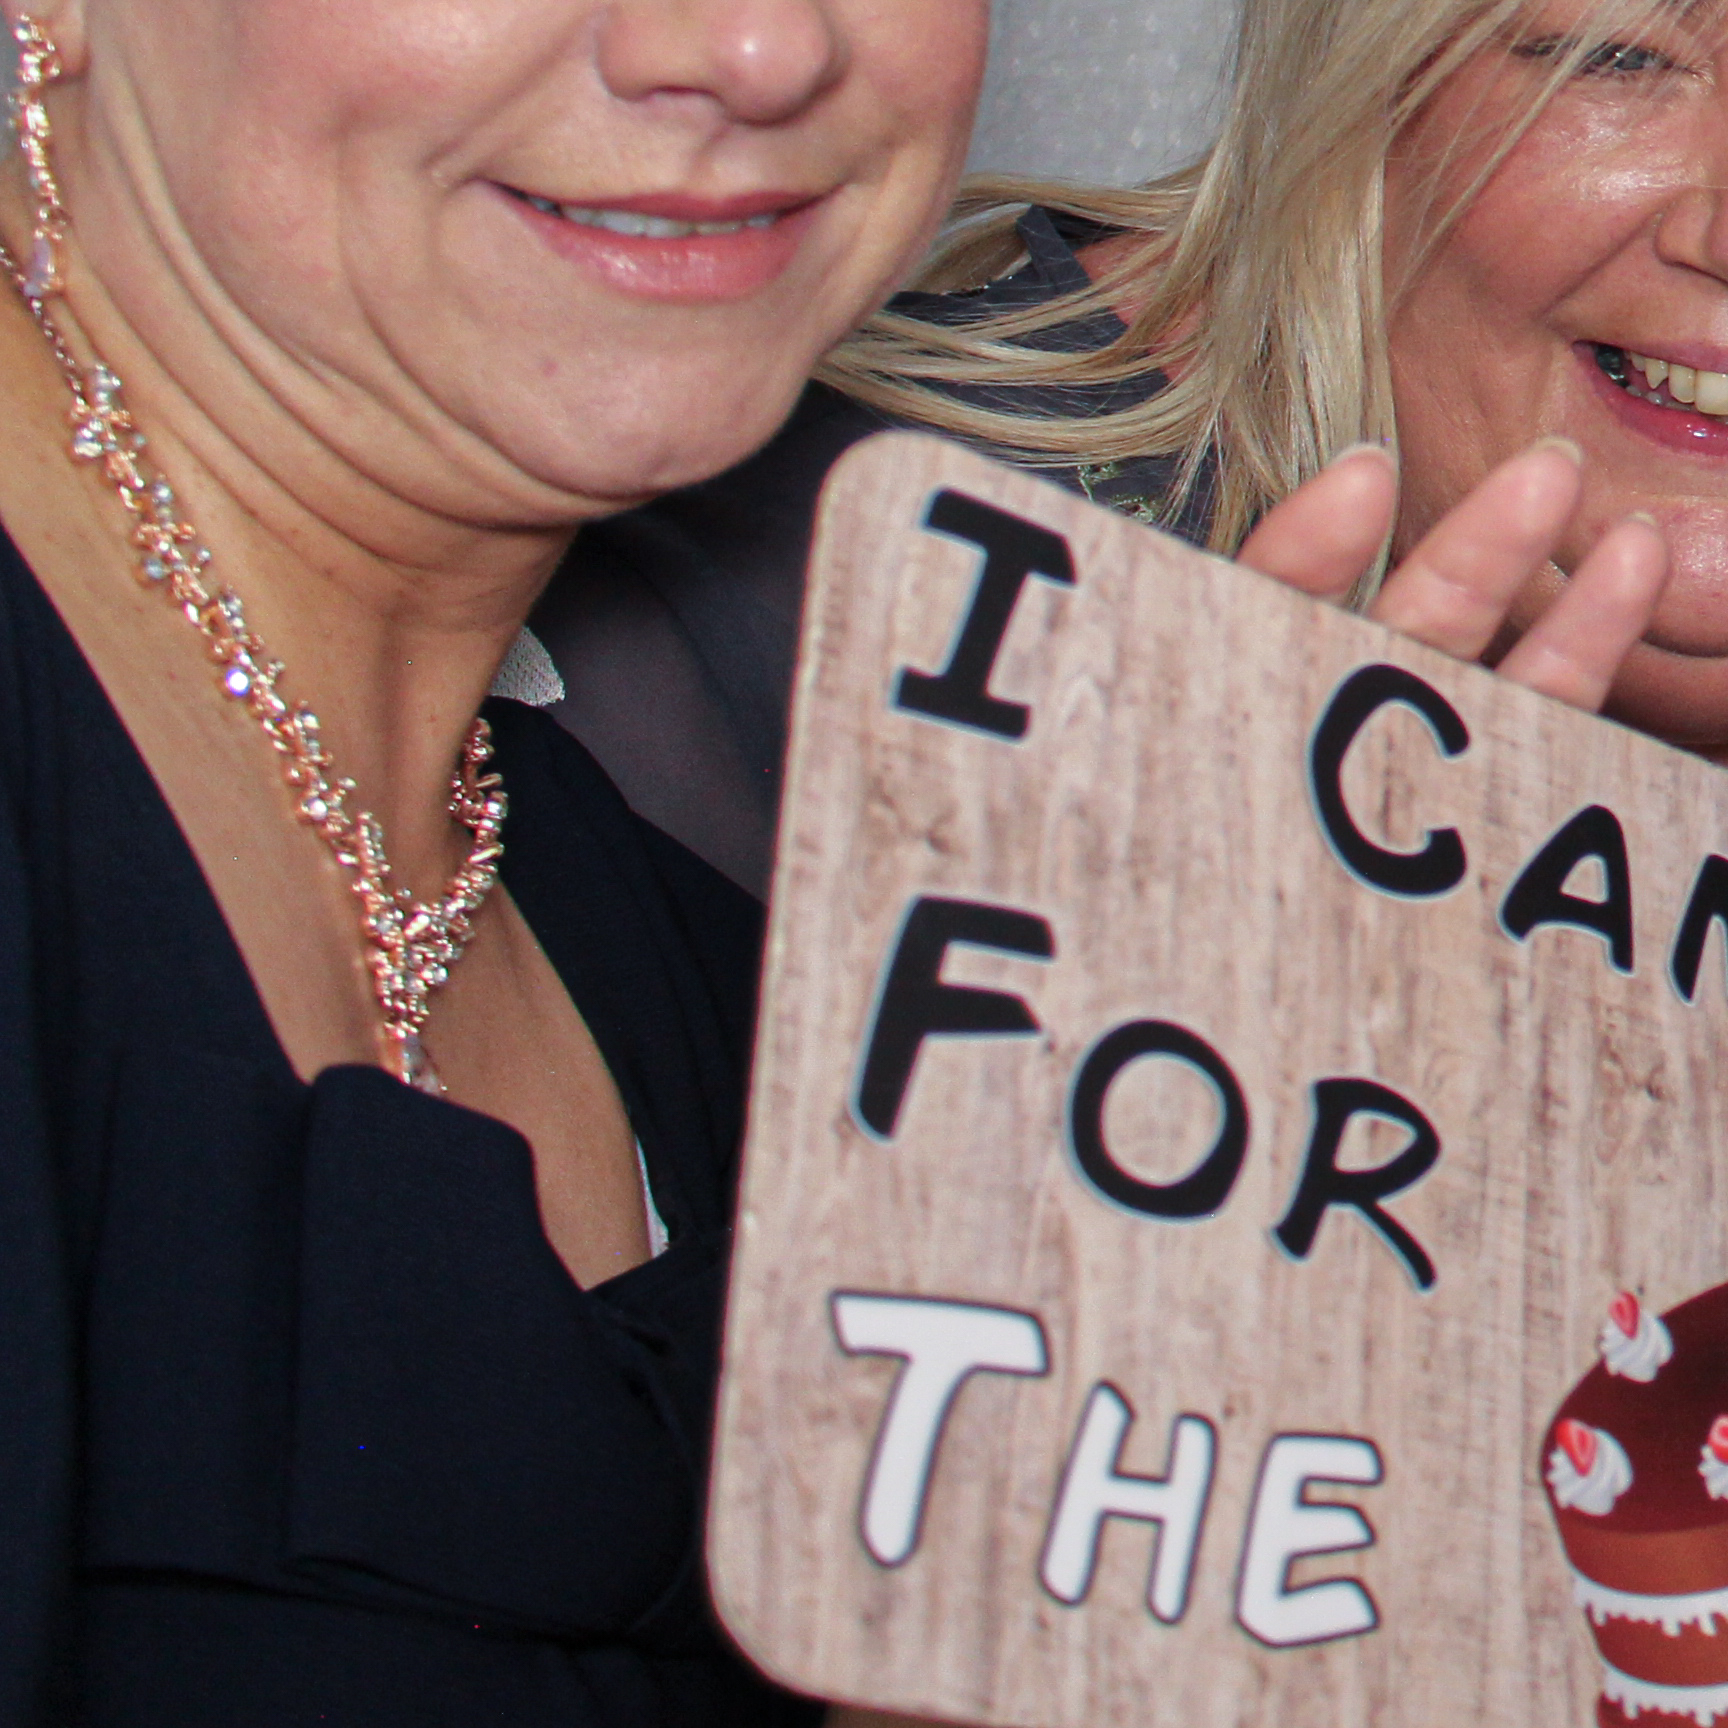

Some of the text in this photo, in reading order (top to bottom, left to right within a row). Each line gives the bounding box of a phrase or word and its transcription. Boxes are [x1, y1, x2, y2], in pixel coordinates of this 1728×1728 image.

[890, 487, 1077, 740] I
[851, 895, 1441, 1292] FOR
[828, 1291, 1385, 1648] THE
